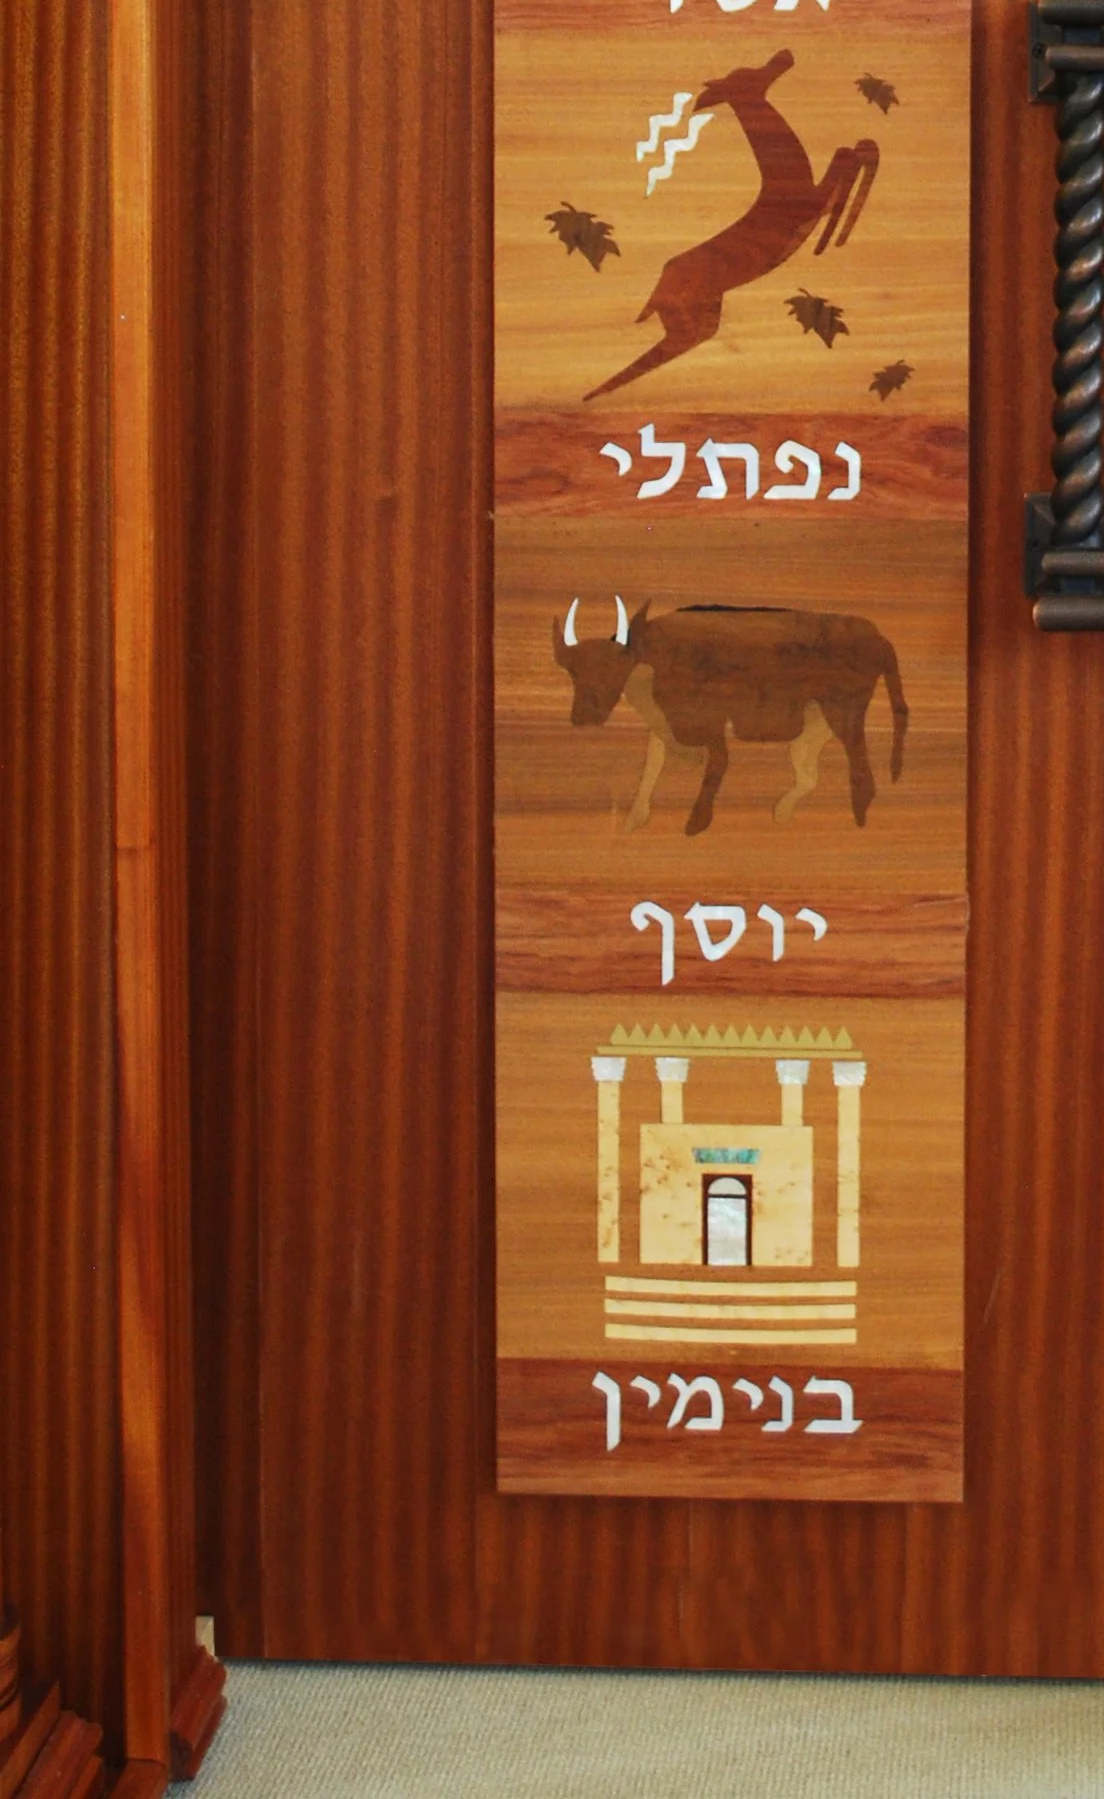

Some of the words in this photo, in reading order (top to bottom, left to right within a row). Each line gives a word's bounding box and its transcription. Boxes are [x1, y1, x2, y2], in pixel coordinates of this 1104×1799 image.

[599, 422, 862, 501] נפתלי
[629, 900, 829, 987] יוסף
[591, 1370, 864, 1452] בנימין
